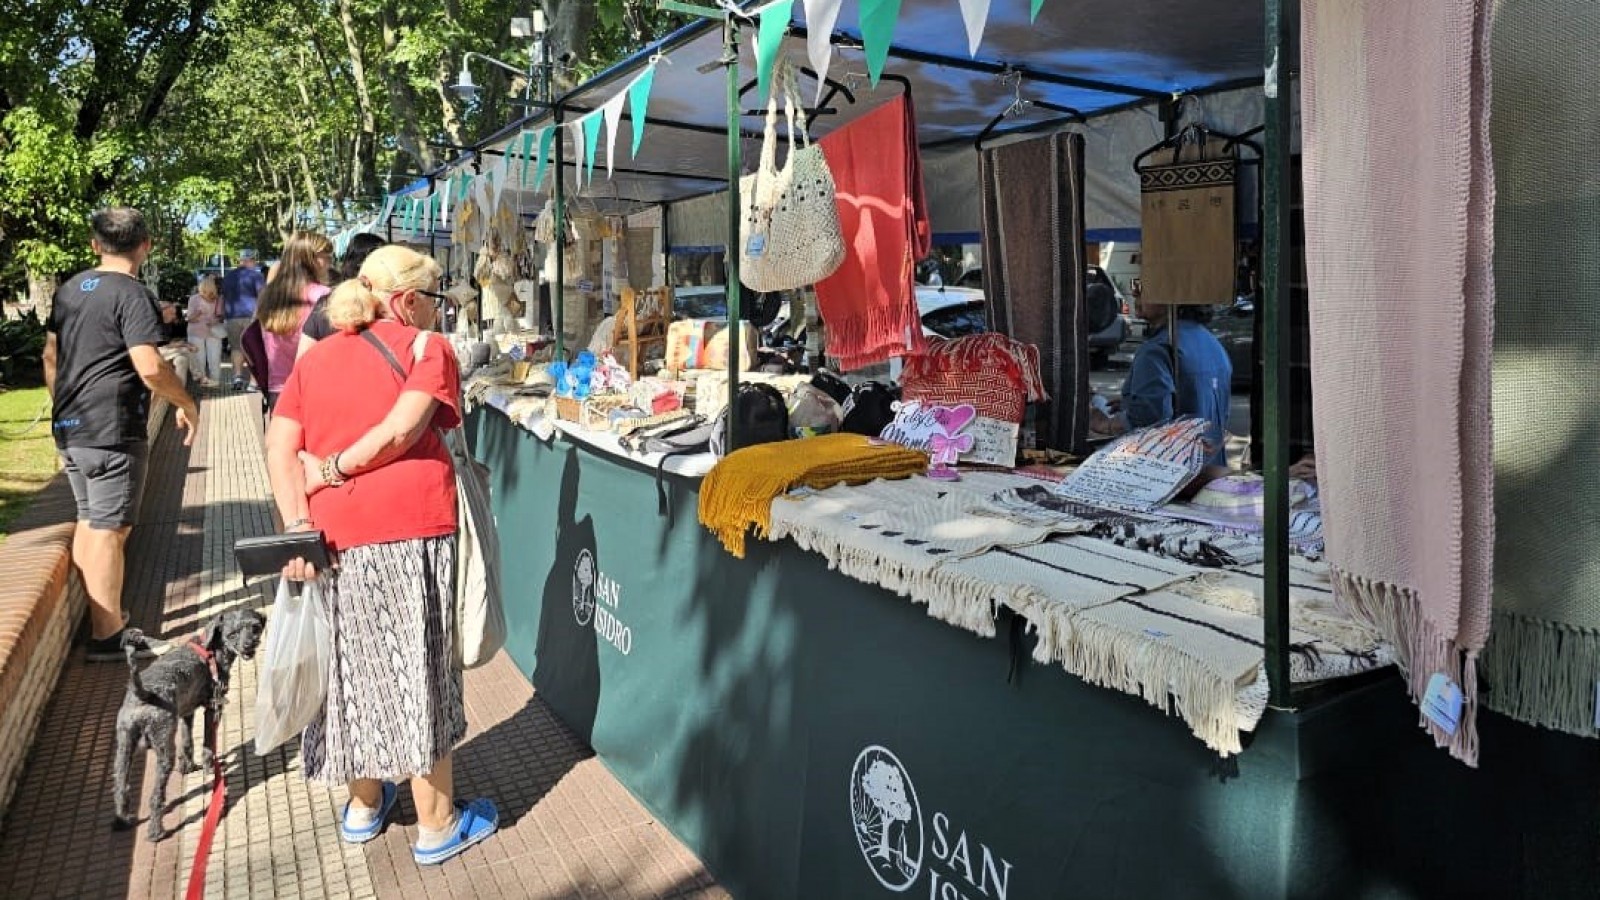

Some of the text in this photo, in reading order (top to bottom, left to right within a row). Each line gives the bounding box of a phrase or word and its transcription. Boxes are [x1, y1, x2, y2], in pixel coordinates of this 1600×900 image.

[597, 571, 620, 610] SAN
[594, 603, 631, 655] ISIDRO
[931, 812, 1014, 900] SAN
